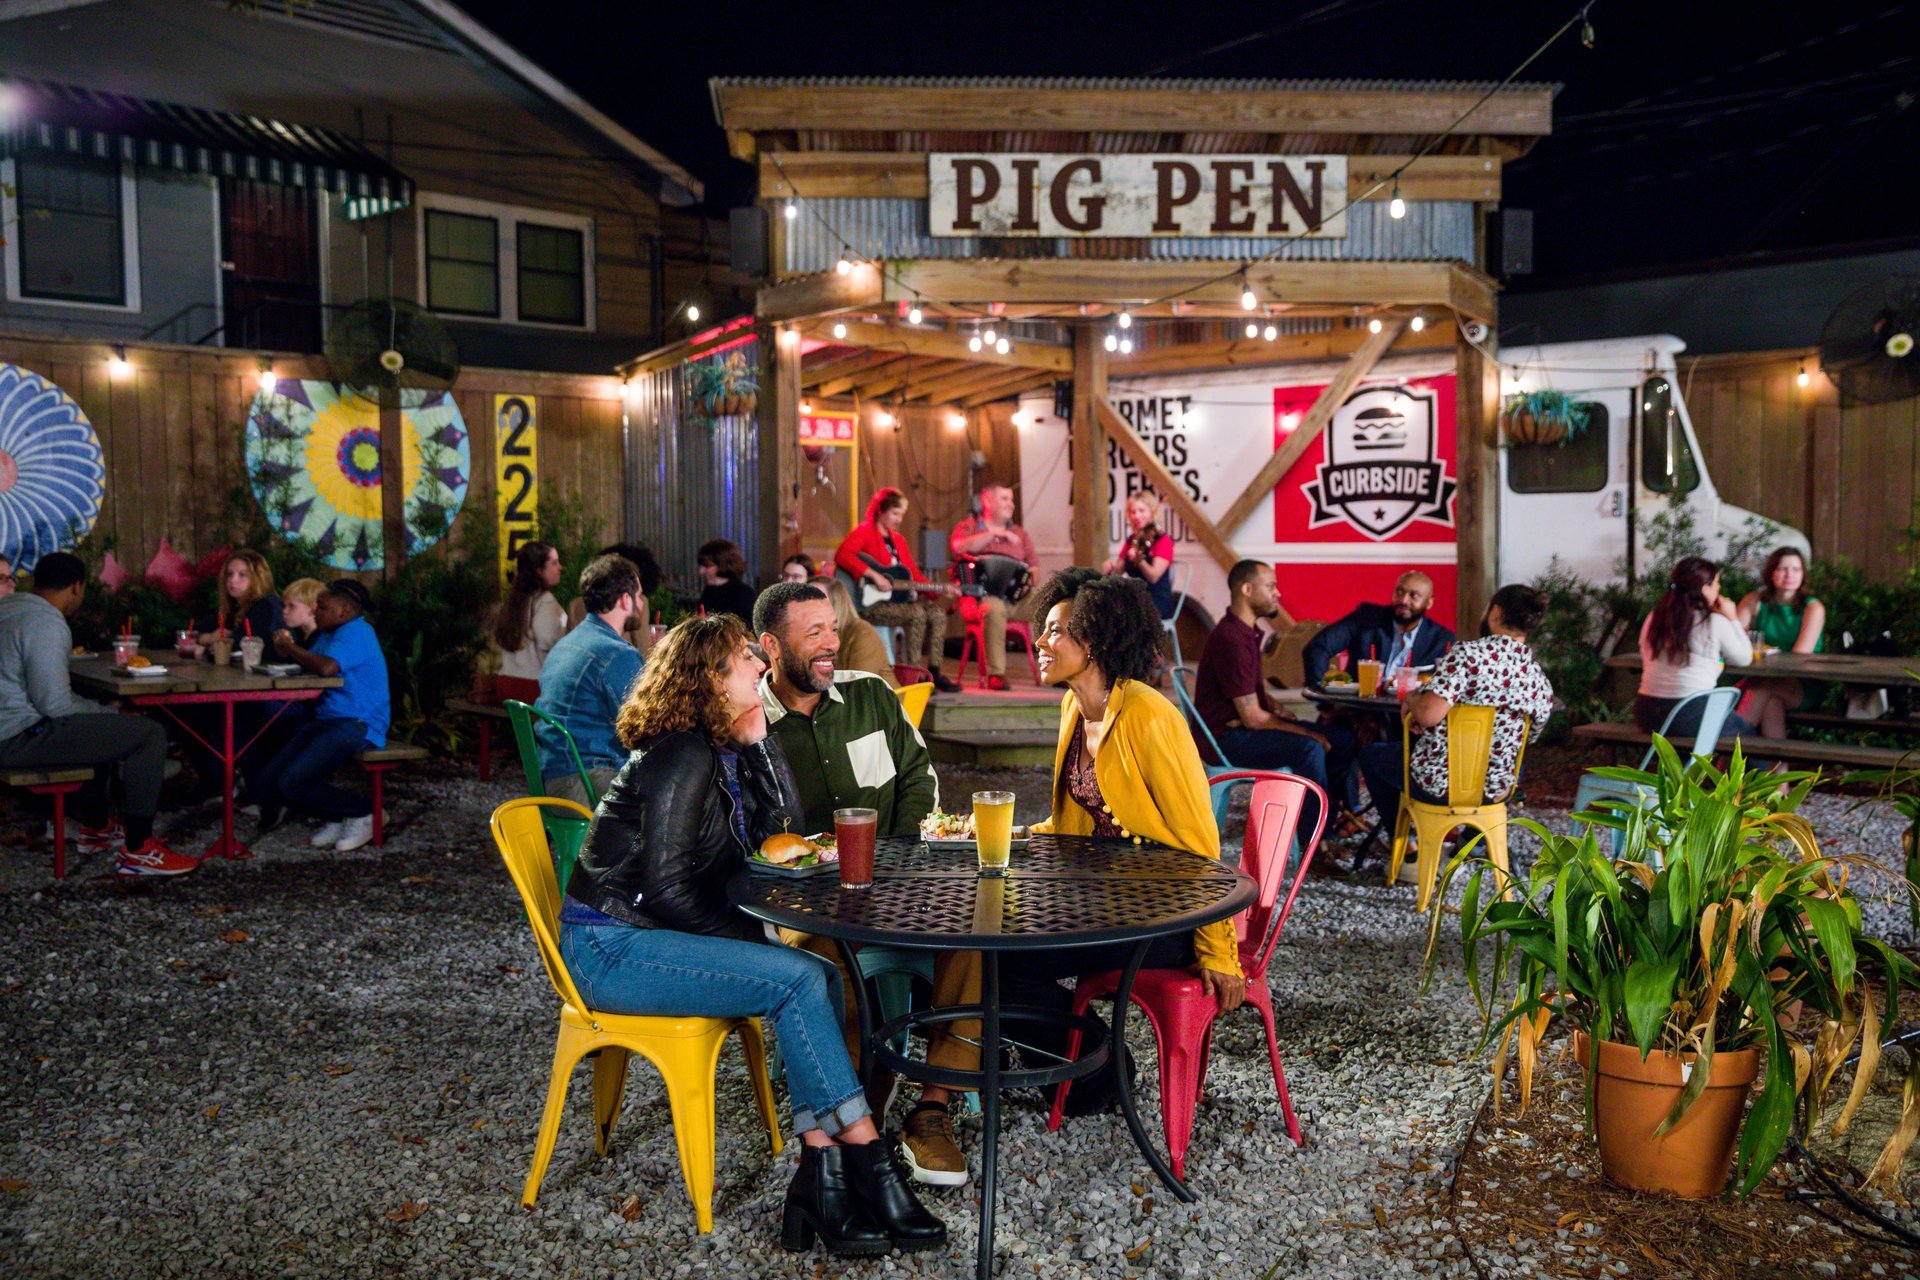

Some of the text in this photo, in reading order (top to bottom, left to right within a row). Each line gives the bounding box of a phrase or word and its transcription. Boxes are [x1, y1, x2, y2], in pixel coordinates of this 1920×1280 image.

[951, 159, 1327, 233] PIG PEN
[1110, 396, 1191, 432] RMET
[1329, 466, 1431, 498] CURBSIDE
